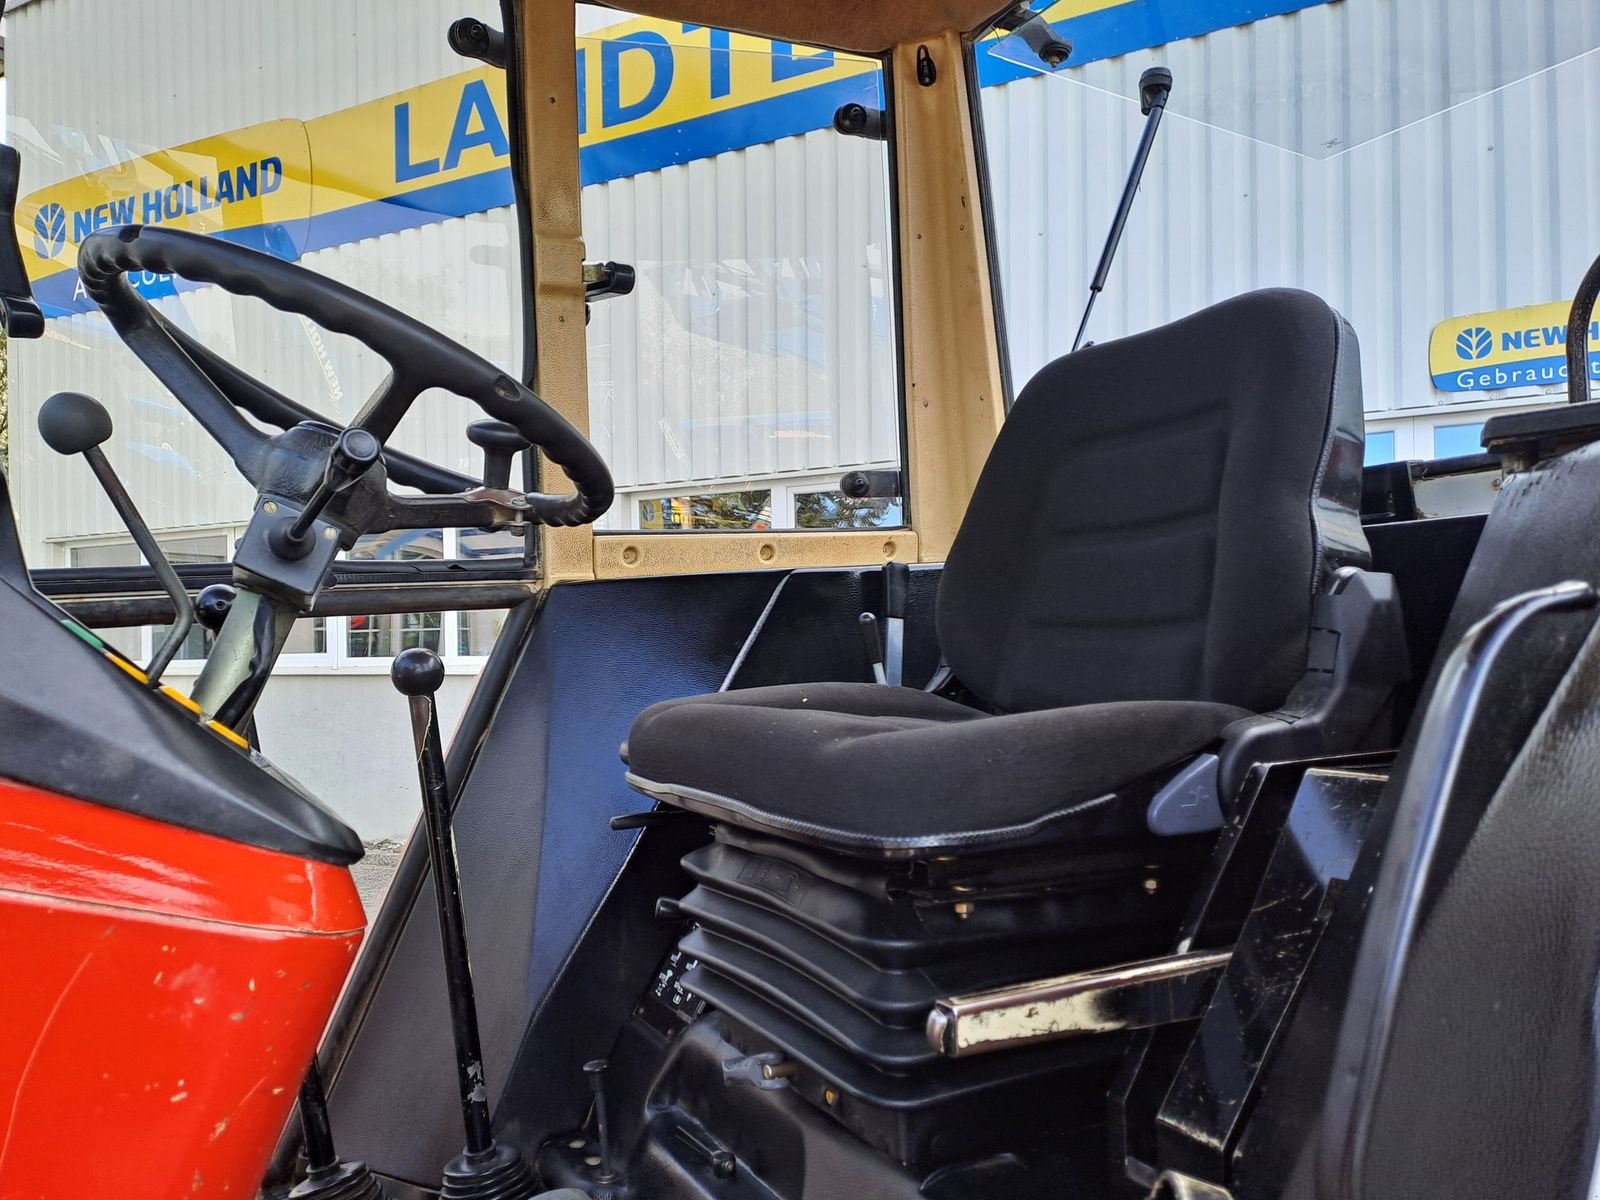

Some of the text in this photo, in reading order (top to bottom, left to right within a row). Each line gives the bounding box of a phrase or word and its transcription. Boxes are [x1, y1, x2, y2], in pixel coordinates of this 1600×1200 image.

[73, 156, 282, 244] NEW HOLLAND
[1501, 324, 1568, 351] NEW
[1456, 359, 1600, 389] Gebrauct
